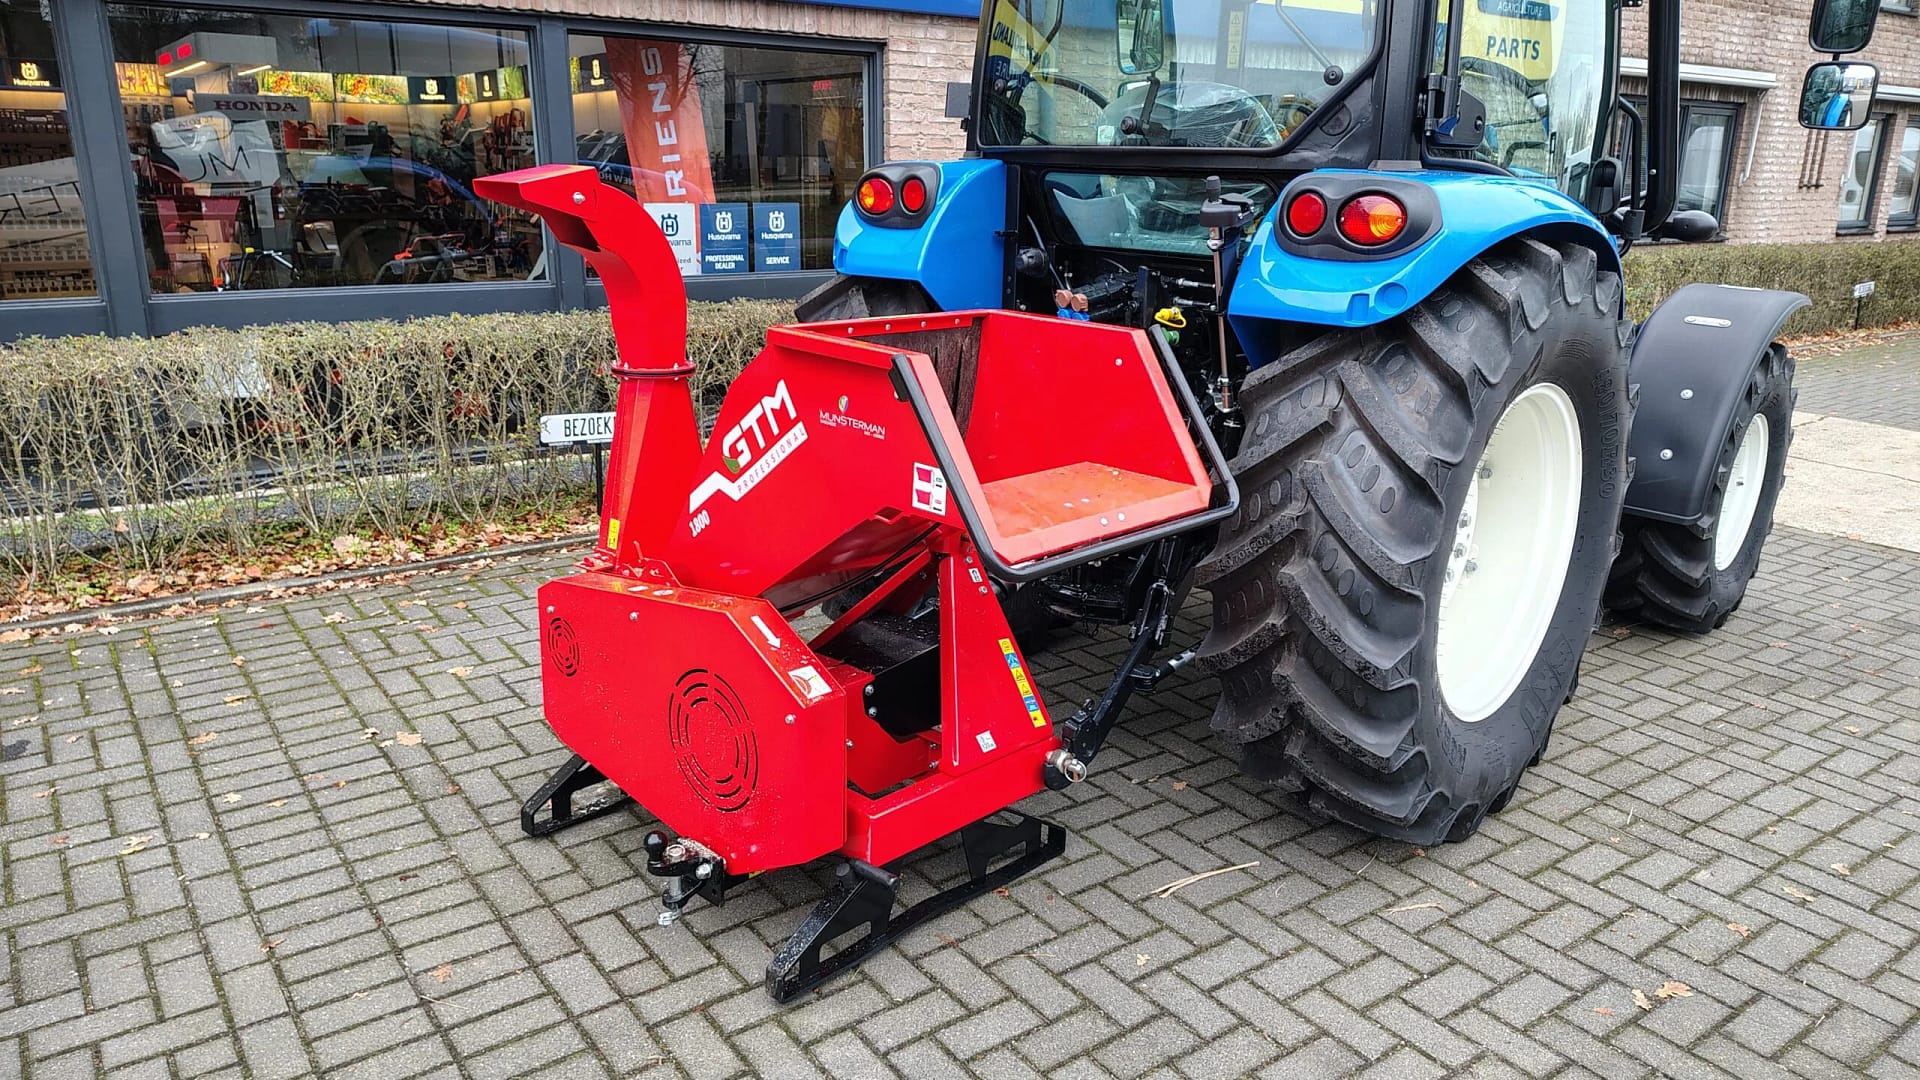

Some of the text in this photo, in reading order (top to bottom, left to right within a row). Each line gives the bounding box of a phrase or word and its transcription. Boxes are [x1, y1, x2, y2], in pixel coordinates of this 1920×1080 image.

[1486, 35, 1541, 60] PARTS
[213, 100, 298, 112] HONDA
[640, 47, 687, 197] RIENS
[707, 232, 742, 241] Husqvarna
[761, 231, 794, 240] Husqvarna
[705, 254, 745, 263] PROFESSIONAL
[714, 262, 736, 270] DEALER
[765, 256, 790, 265] SERVICE
[564, 416, 616, 438] BEZOEK
[722, 378, 798, 474] GTM
[819, 408, 886, 435] MUNSTERMAN
[737, 427, 806, 494] PROFESSIONAL
[688, 509, 711, 538] 1800
